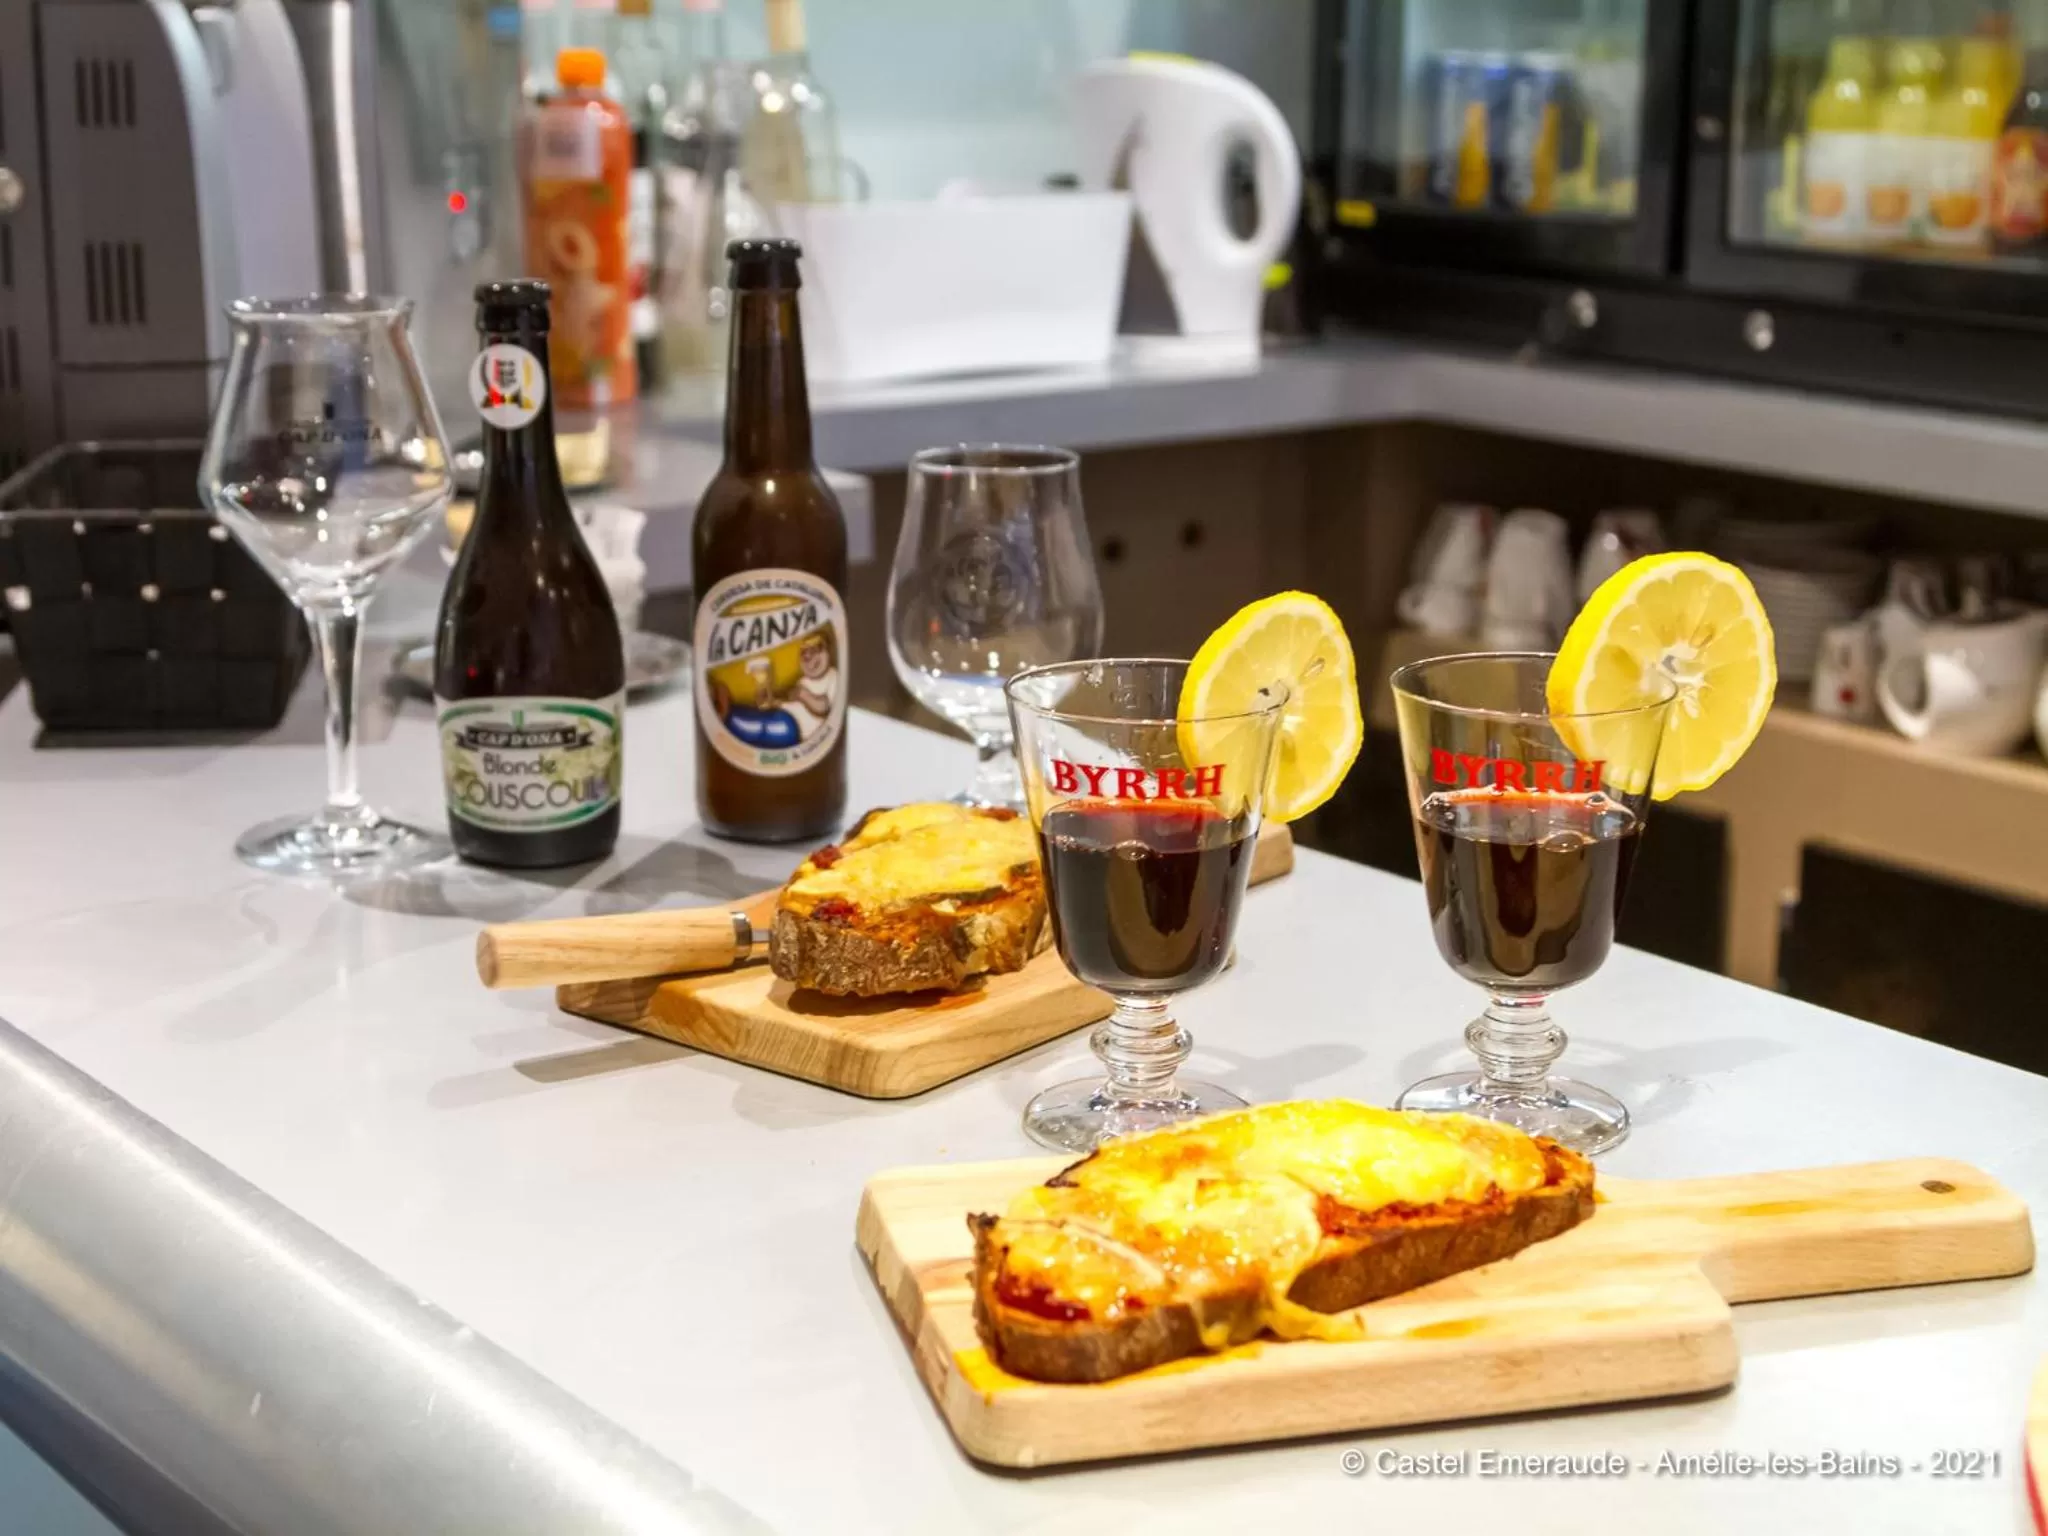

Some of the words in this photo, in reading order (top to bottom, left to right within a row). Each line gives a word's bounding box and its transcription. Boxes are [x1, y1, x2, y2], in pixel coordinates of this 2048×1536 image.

[729, 603, 818, 656] CANYA
[483, 751, 558, 776] Blonde
[1051, 759, 1226, 801] BYRRH
[1431, 746, 1606, 793] BYRRH
